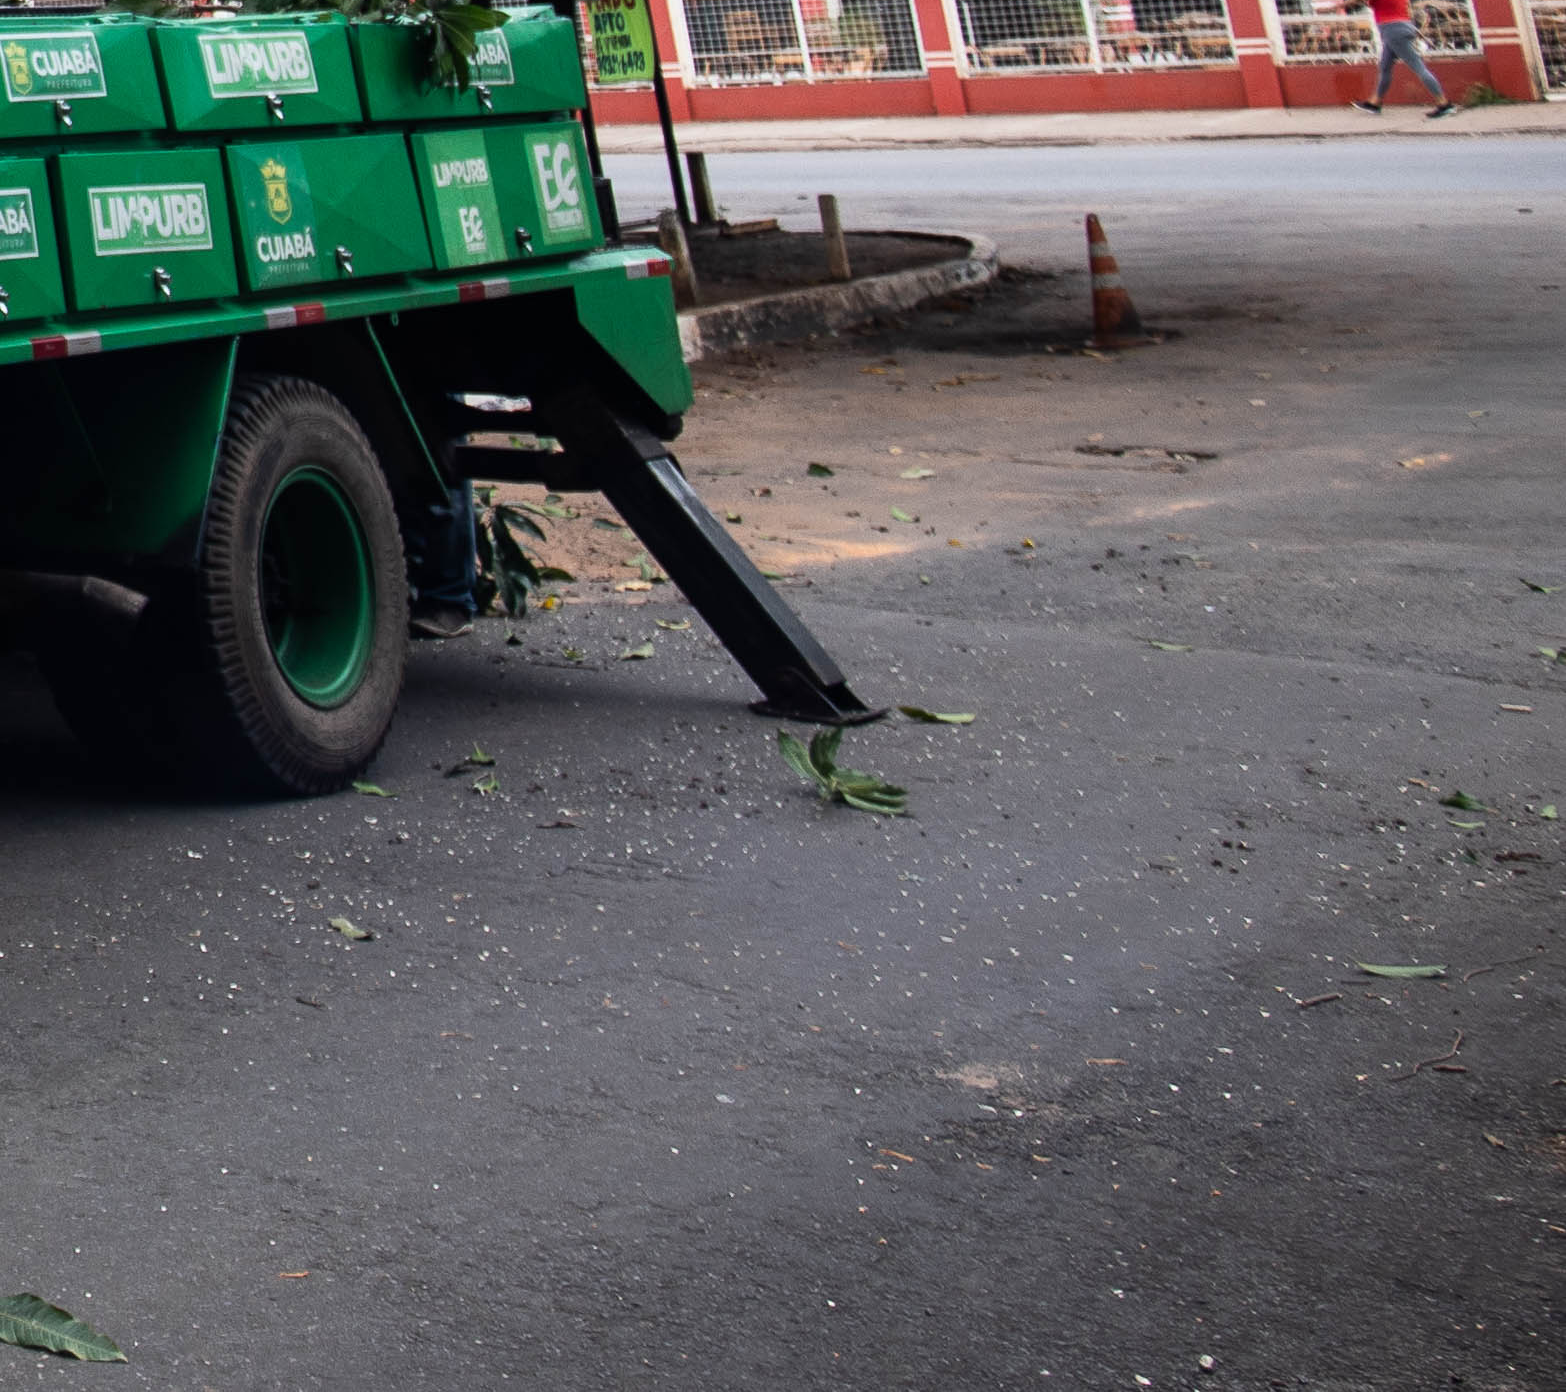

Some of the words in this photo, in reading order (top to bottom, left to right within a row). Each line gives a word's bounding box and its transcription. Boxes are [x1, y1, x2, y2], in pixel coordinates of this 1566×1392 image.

[32, 44, 98, 77] CUIABÁ
[204, 40, 311, 84] LIMPURB
[466, 36, 508, 66] IABÁ
[433, 157, 489, 188] LIMPURB
[93, 193, 207, 241] LIMPURB
[257, 226, 316, 263] CUIABÁ
